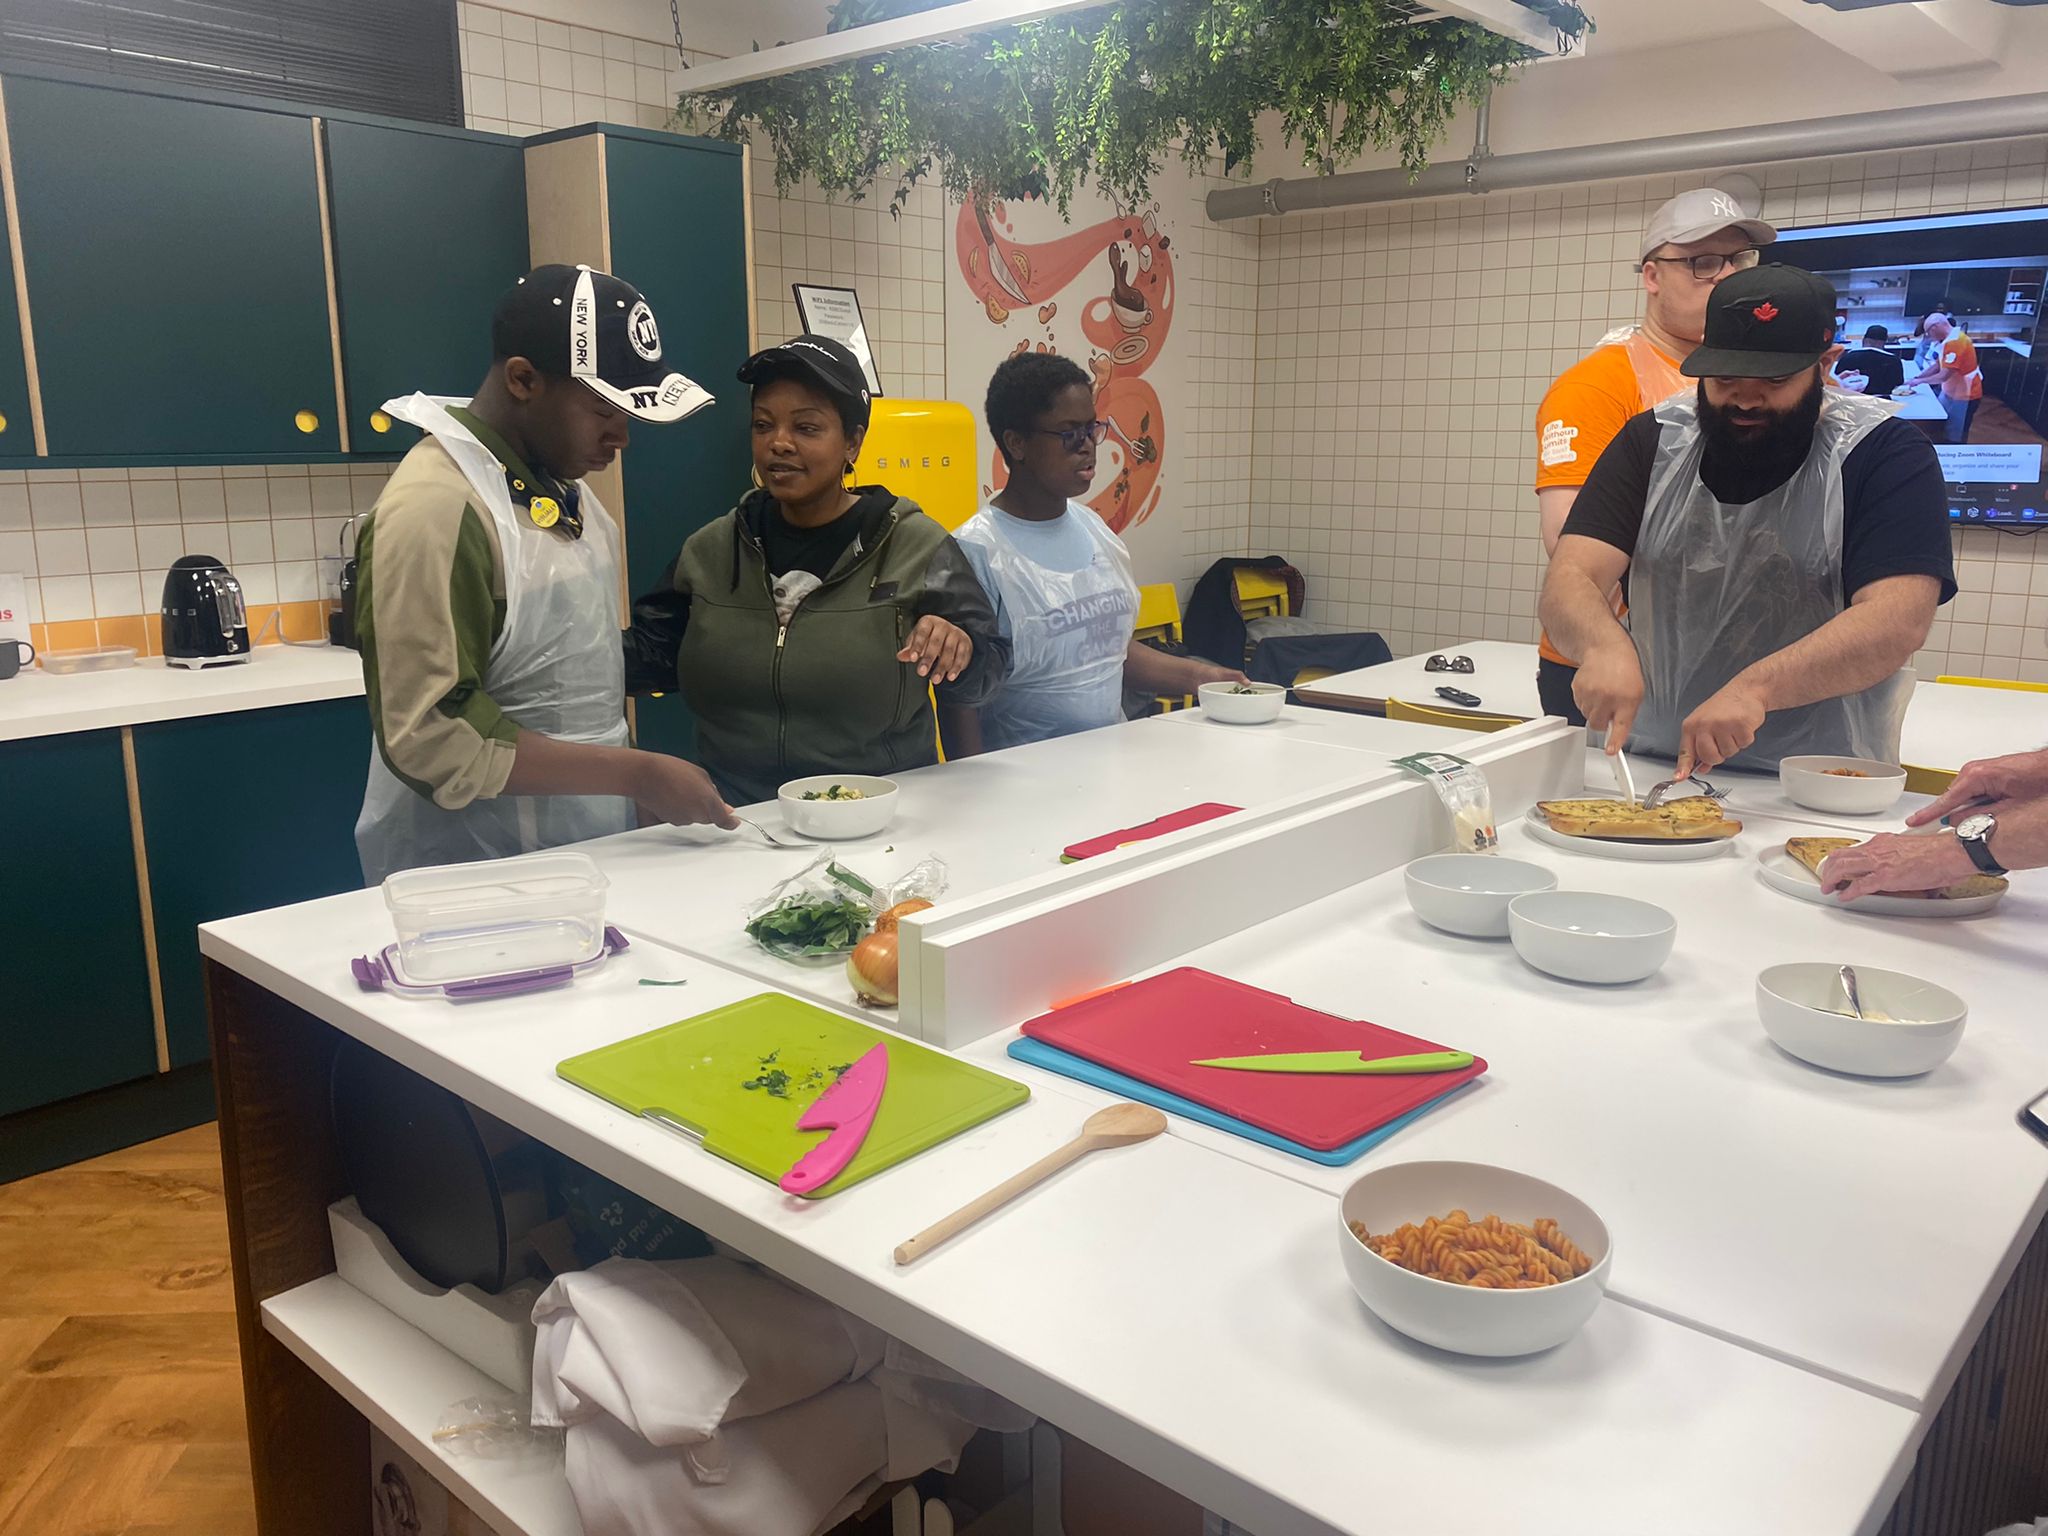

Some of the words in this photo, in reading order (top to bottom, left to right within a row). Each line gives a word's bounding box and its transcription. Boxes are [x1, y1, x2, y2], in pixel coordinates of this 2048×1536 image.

[1710, 196, 1737, 218] NY
[576, 298, 588, 326] NEW
[576, 332, 588, 367] YORK
[630, 391, 658, 409] NY
[877, 456, 951, 469] SMEG
